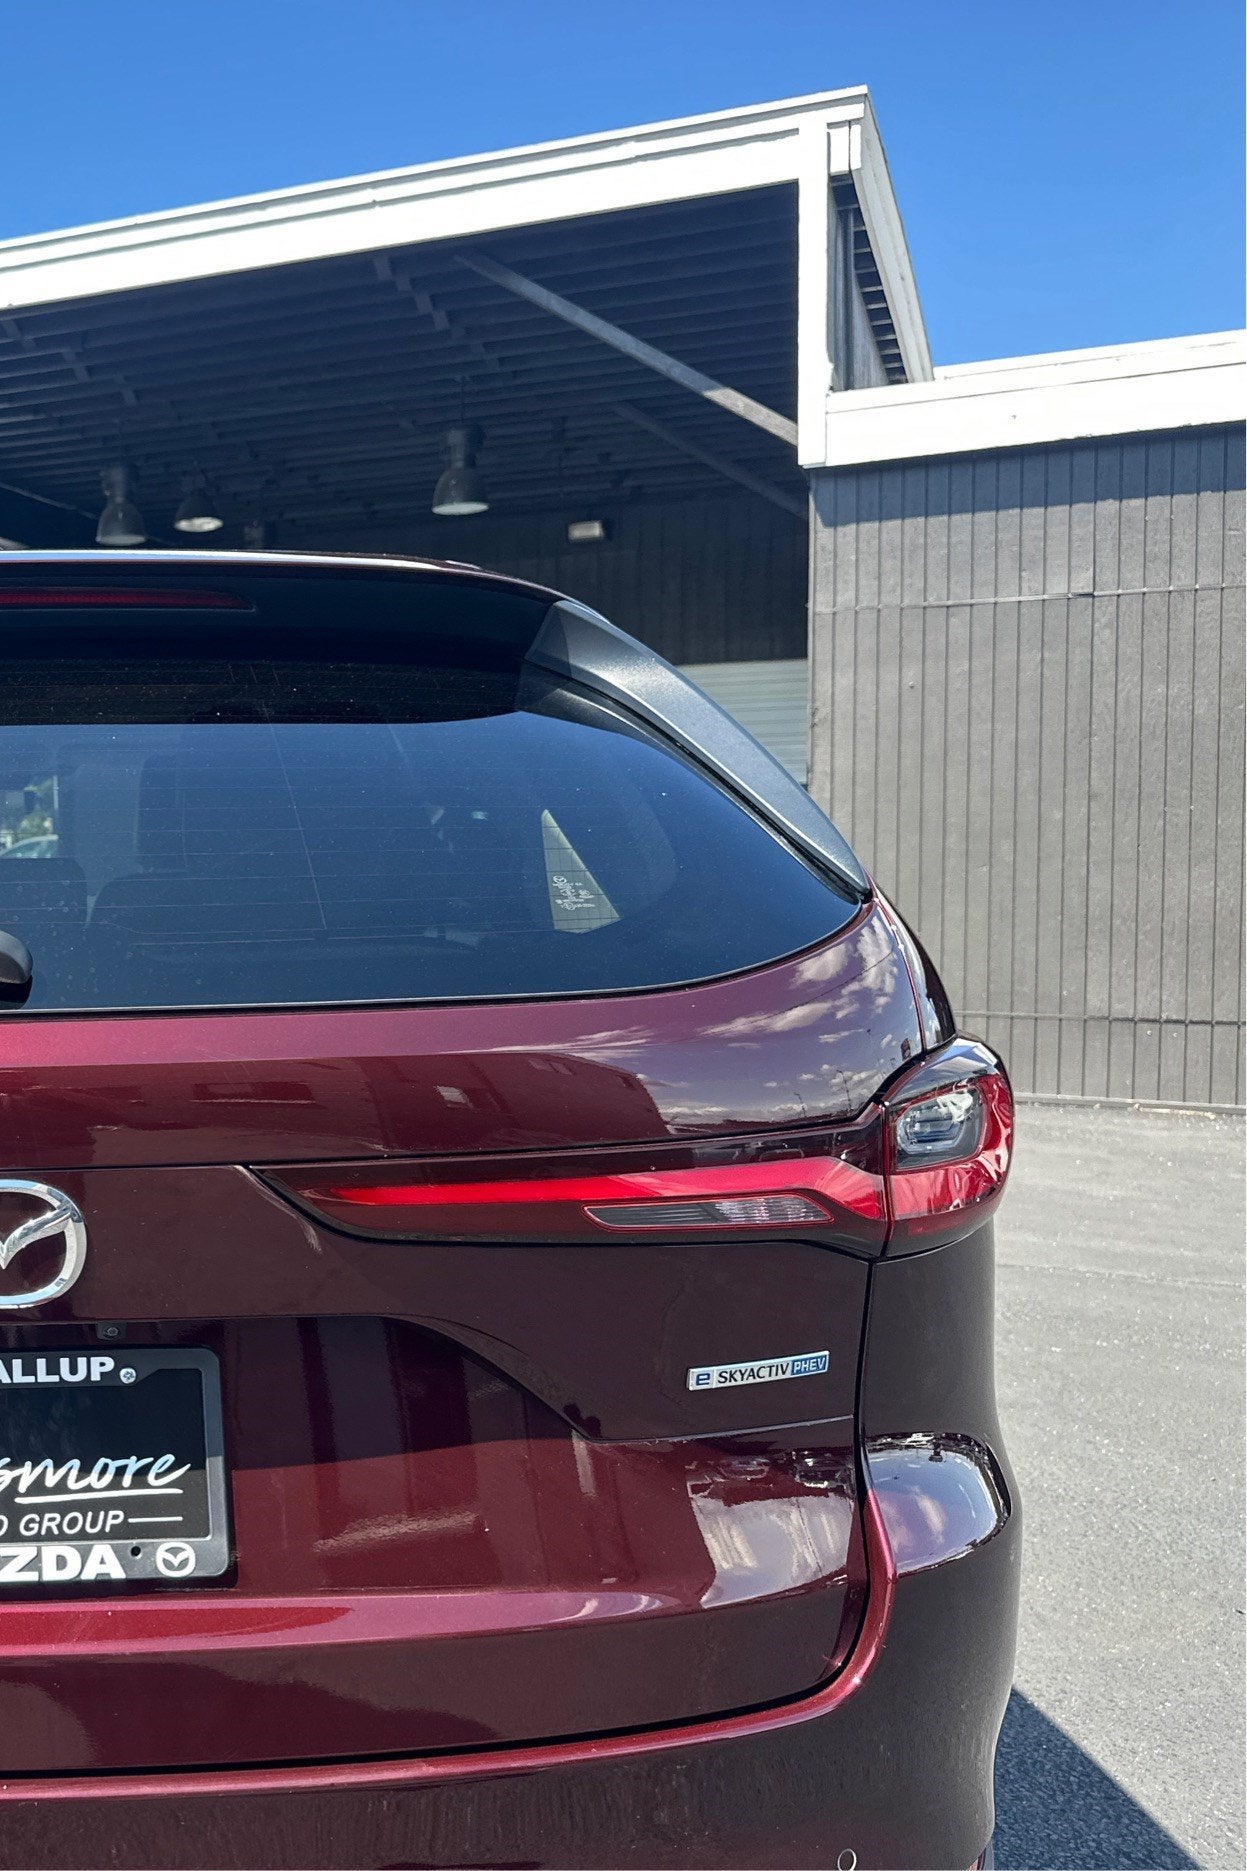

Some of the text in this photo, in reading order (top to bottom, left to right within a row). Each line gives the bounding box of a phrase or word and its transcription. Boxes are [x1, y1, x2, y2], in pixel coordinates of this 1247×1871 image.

[718, 1363, 789, 1384] SKYACTIV
[793, 1357, 825, 1374] PHEV
[19, 1510, 125, 1536] GROUP
